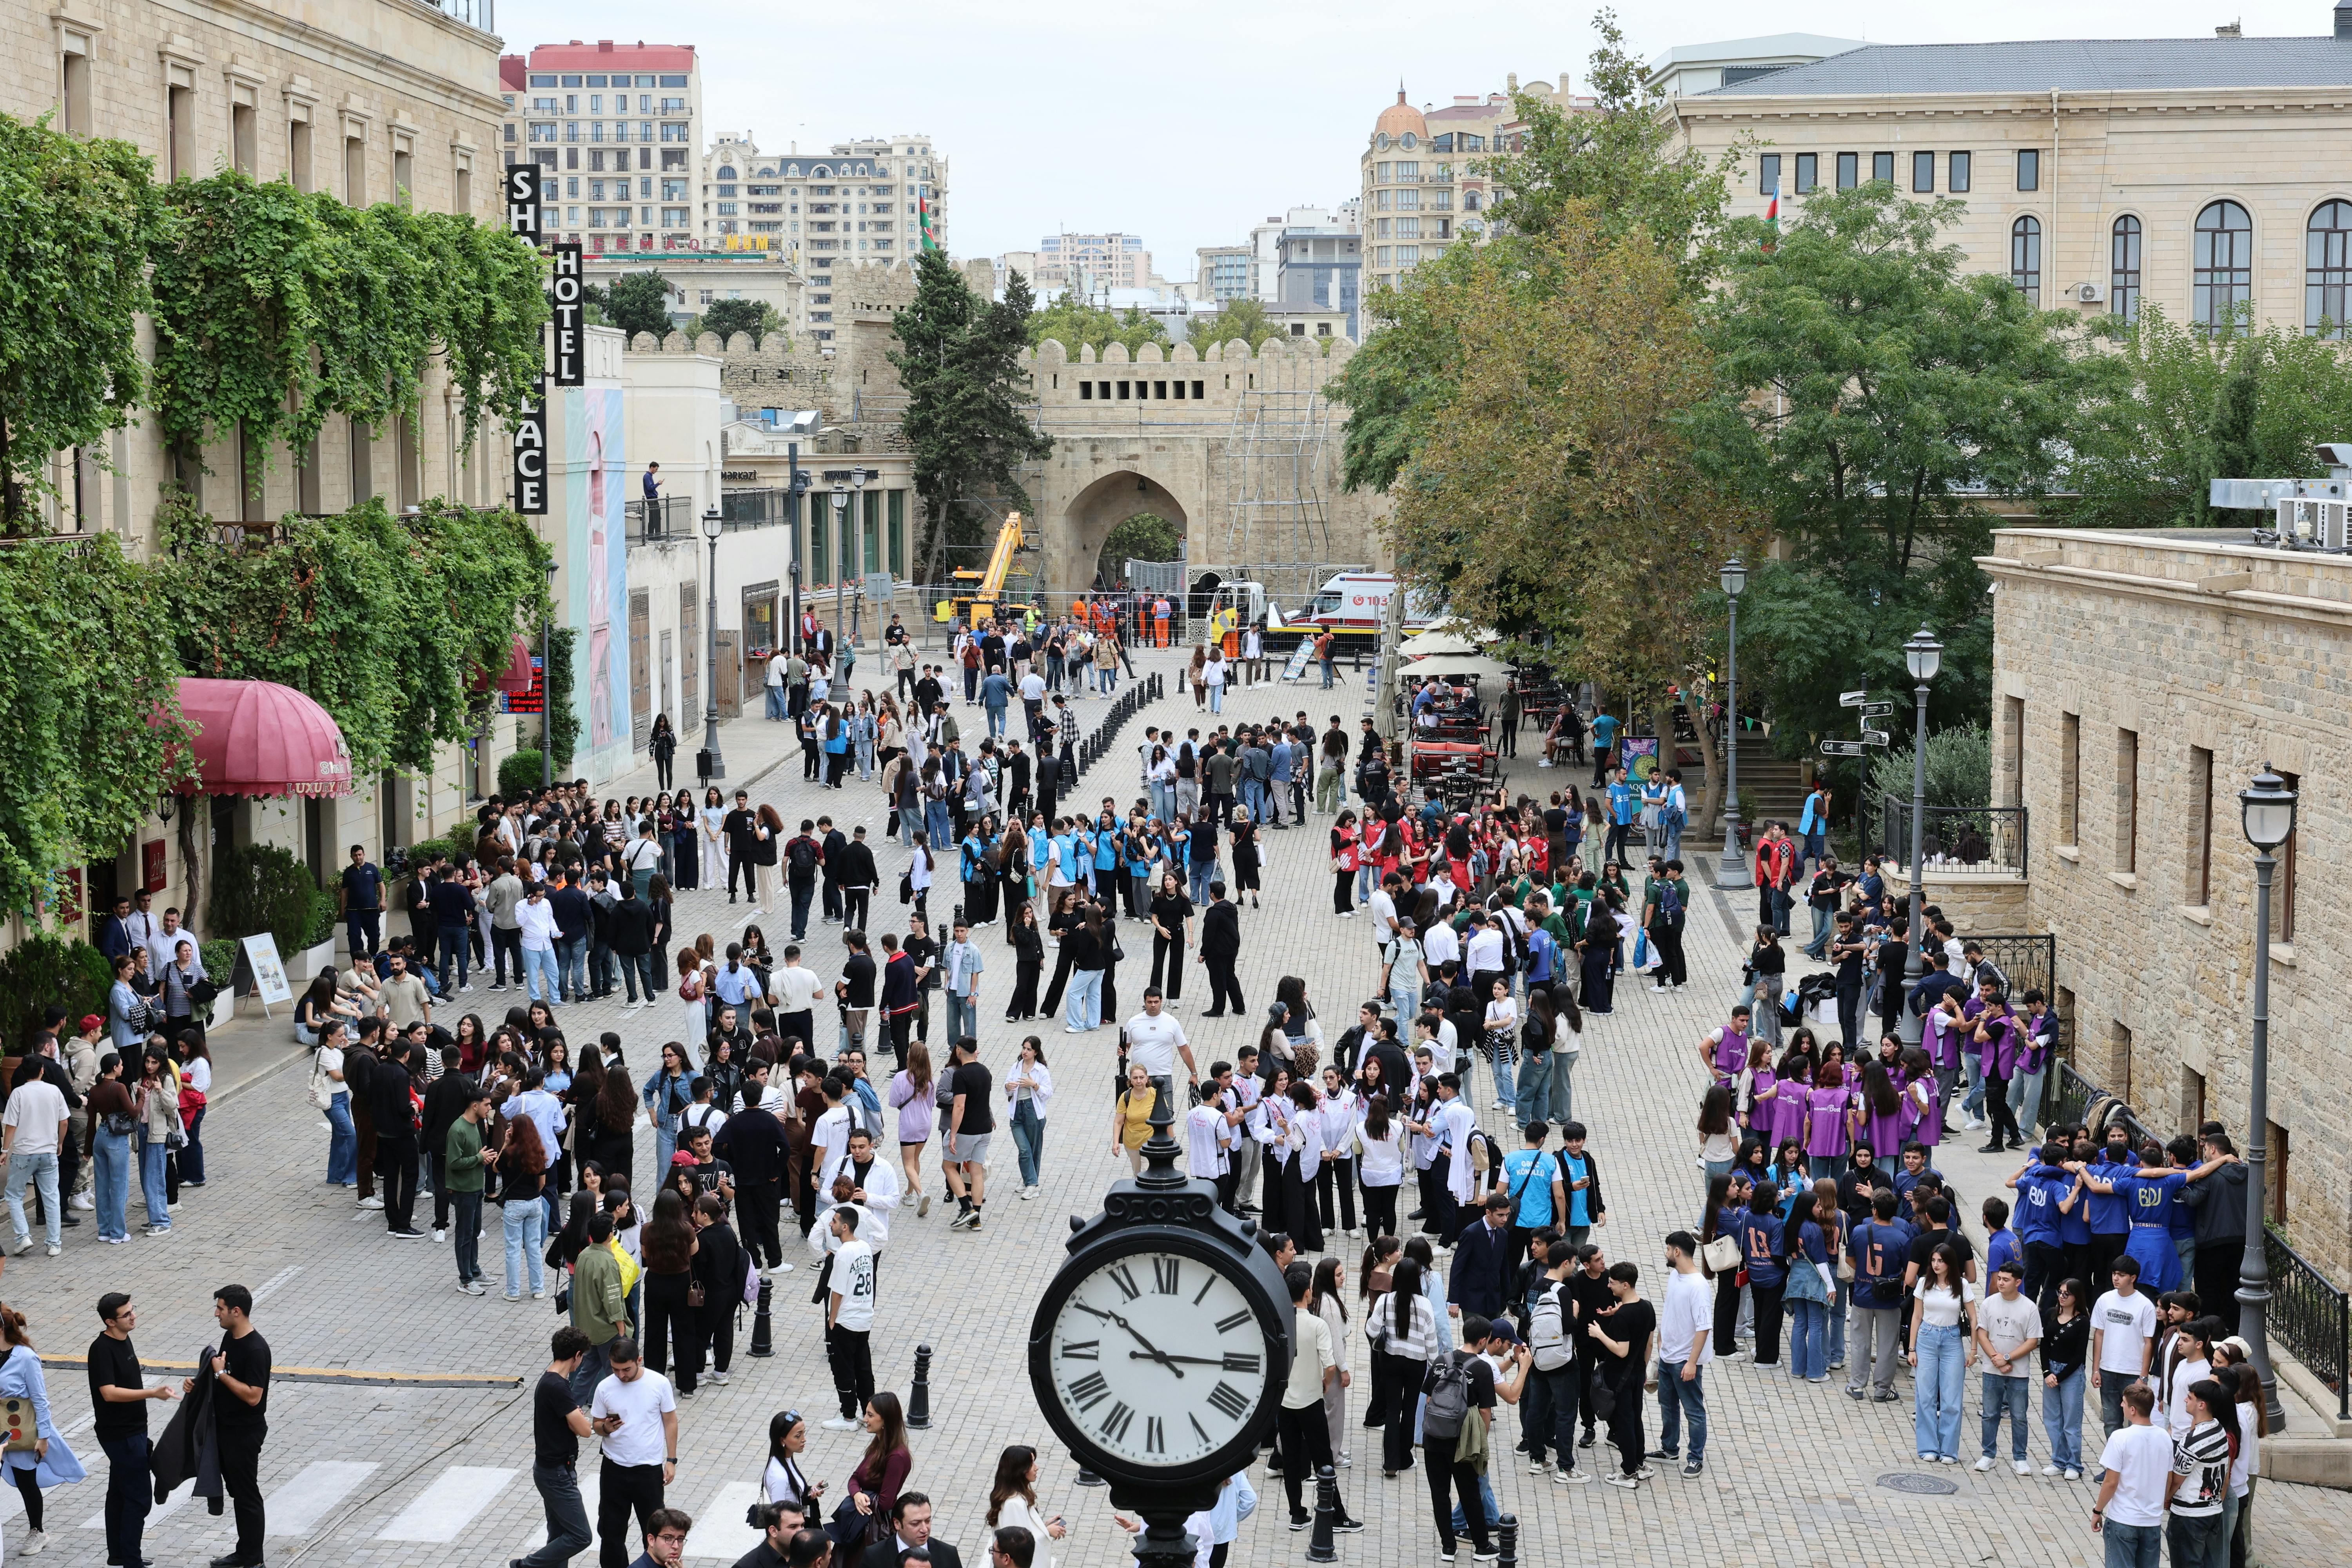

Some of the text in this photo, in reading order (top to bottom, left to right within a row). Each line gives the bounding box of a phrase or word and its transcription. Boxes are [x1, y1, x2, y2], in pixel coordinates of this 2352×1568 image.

[727, 235, 768, 250] MUM
[555, 251, 579, 379] HOTEL
[1367, 596, 1388, 606] 103
[287, 782, 336, 794] LUXURY
[1748, 1227, 1771, 1258] 13
[853, 1272, 871, 1296] 28
[1107, 1263, 1142, 1304] XI
[1151, 1257, 1180, 1295] XII
[1192, 1274, 1218, 1306] I
[1074, 1296, 1111, 1327] X
[1214, 1308, 1252, 1335] II
[1062, 1339, 1100, 1361] IX
[1223, 1351, 1260, 1374] III
[1067, 1369, 1112, 1414] VIII
[1099, 1400, 1135, 1443] VII
[1145, 1416, 1165, 1454] VI
[1188, 1411, 1212, 1447] V
